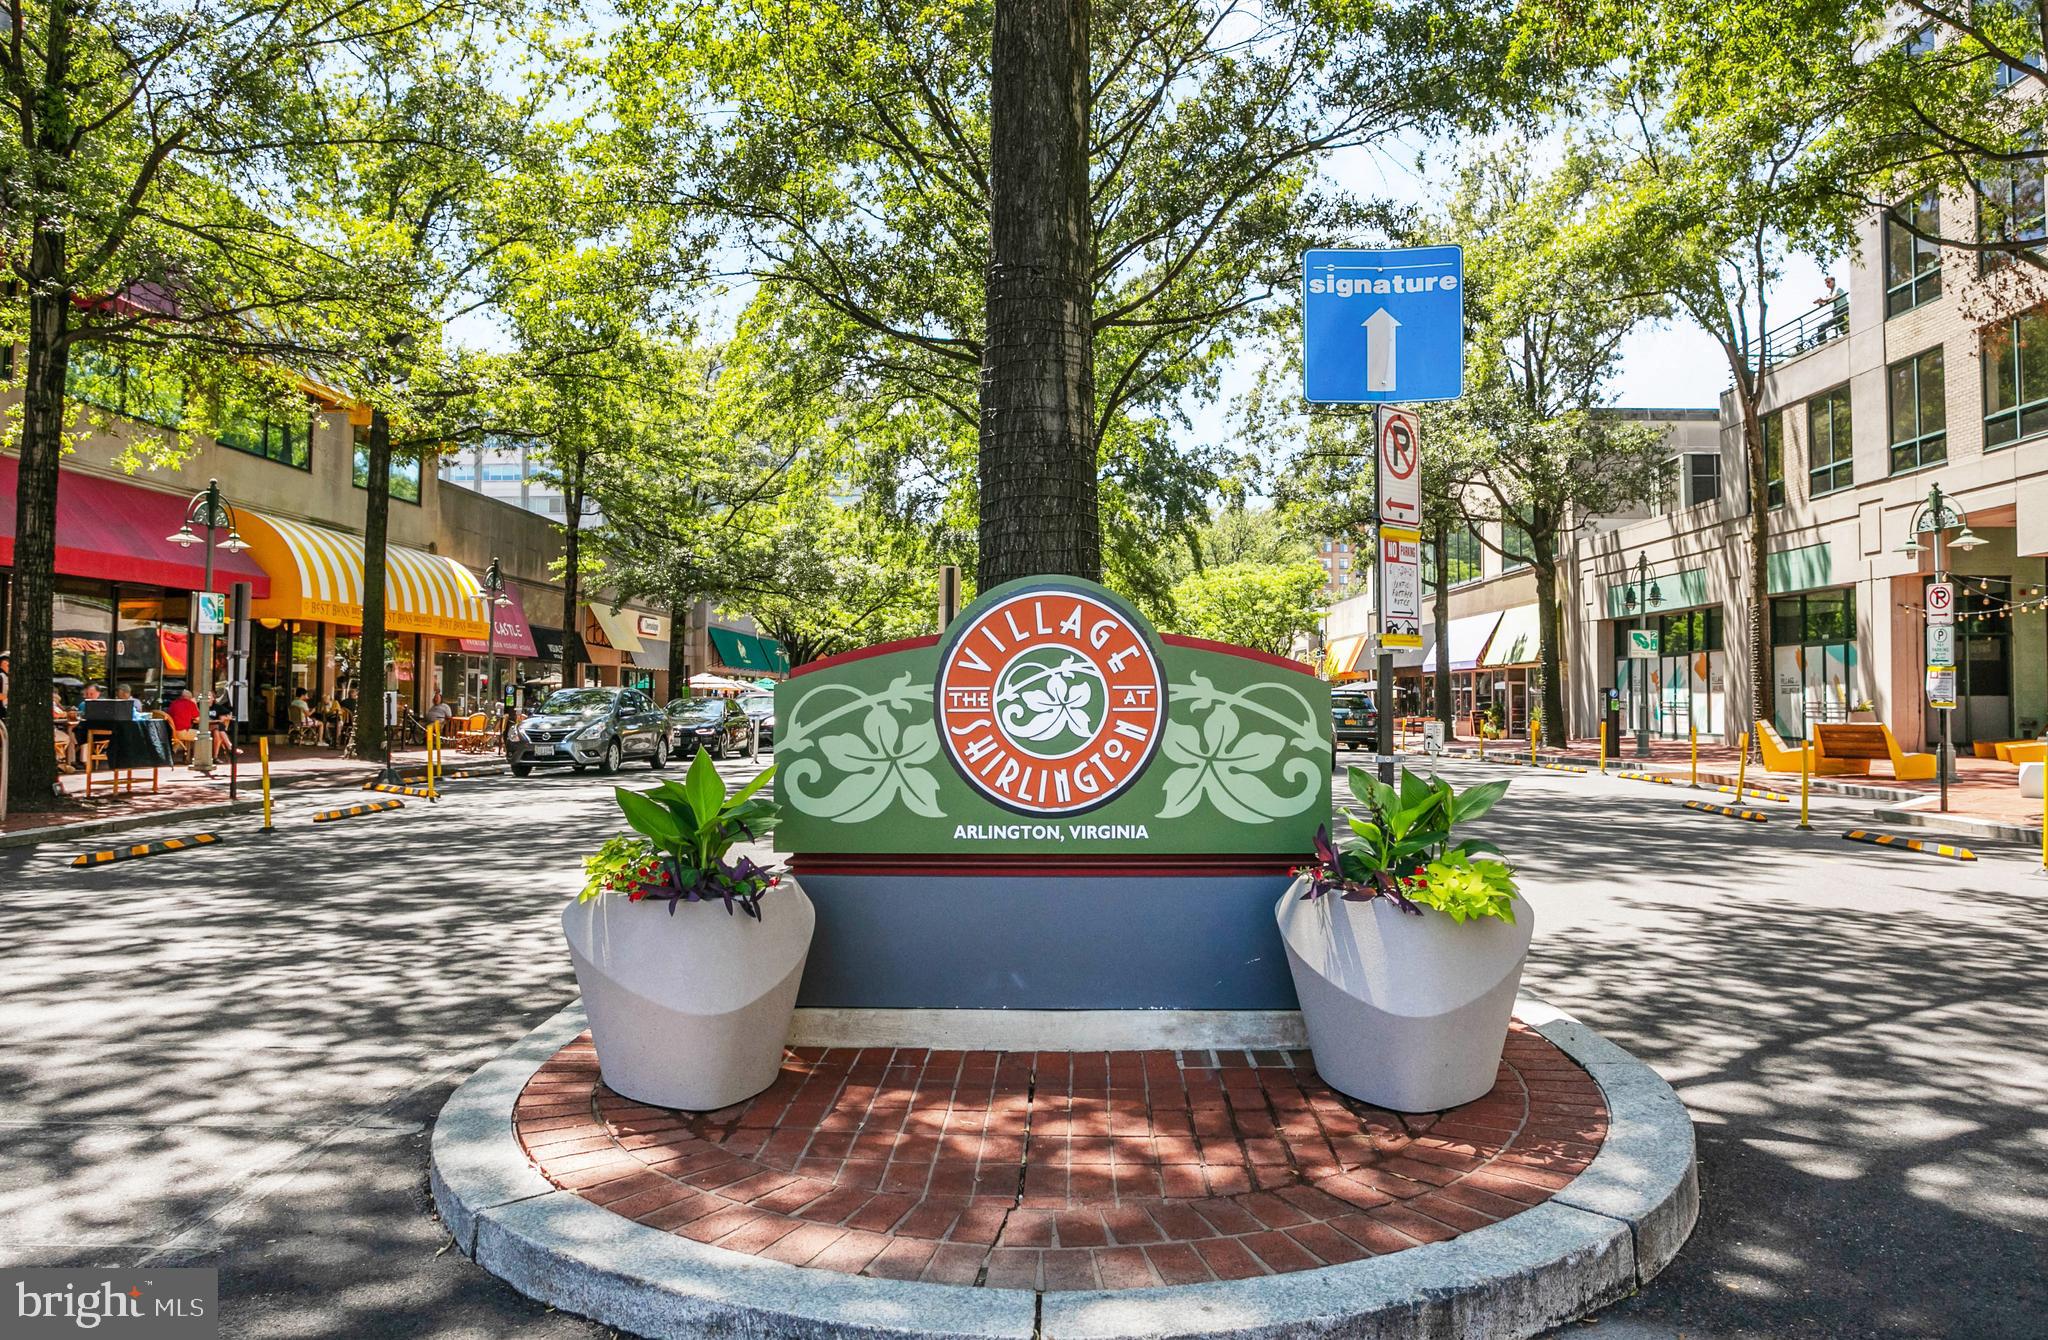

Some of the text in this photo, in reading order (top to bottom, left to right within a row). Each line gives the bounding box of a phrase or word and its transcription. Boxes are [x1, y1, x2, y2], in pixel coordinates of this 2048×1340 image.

[1309, 274, 1458, 297] signature
[1387, 541, 1415, 558] NO PARKING
[494, 621, 522, 638] CASTLE
[957, 601, 1141, 674] VILLAGE
[949, 692, 989, 707] THE
[1123, 690, 1150, 705] AT
[951, 718, 1149, 803] SHIRLINGTON
[953, 825, 1149, 841] ARLINGTON, VIRGINIA
